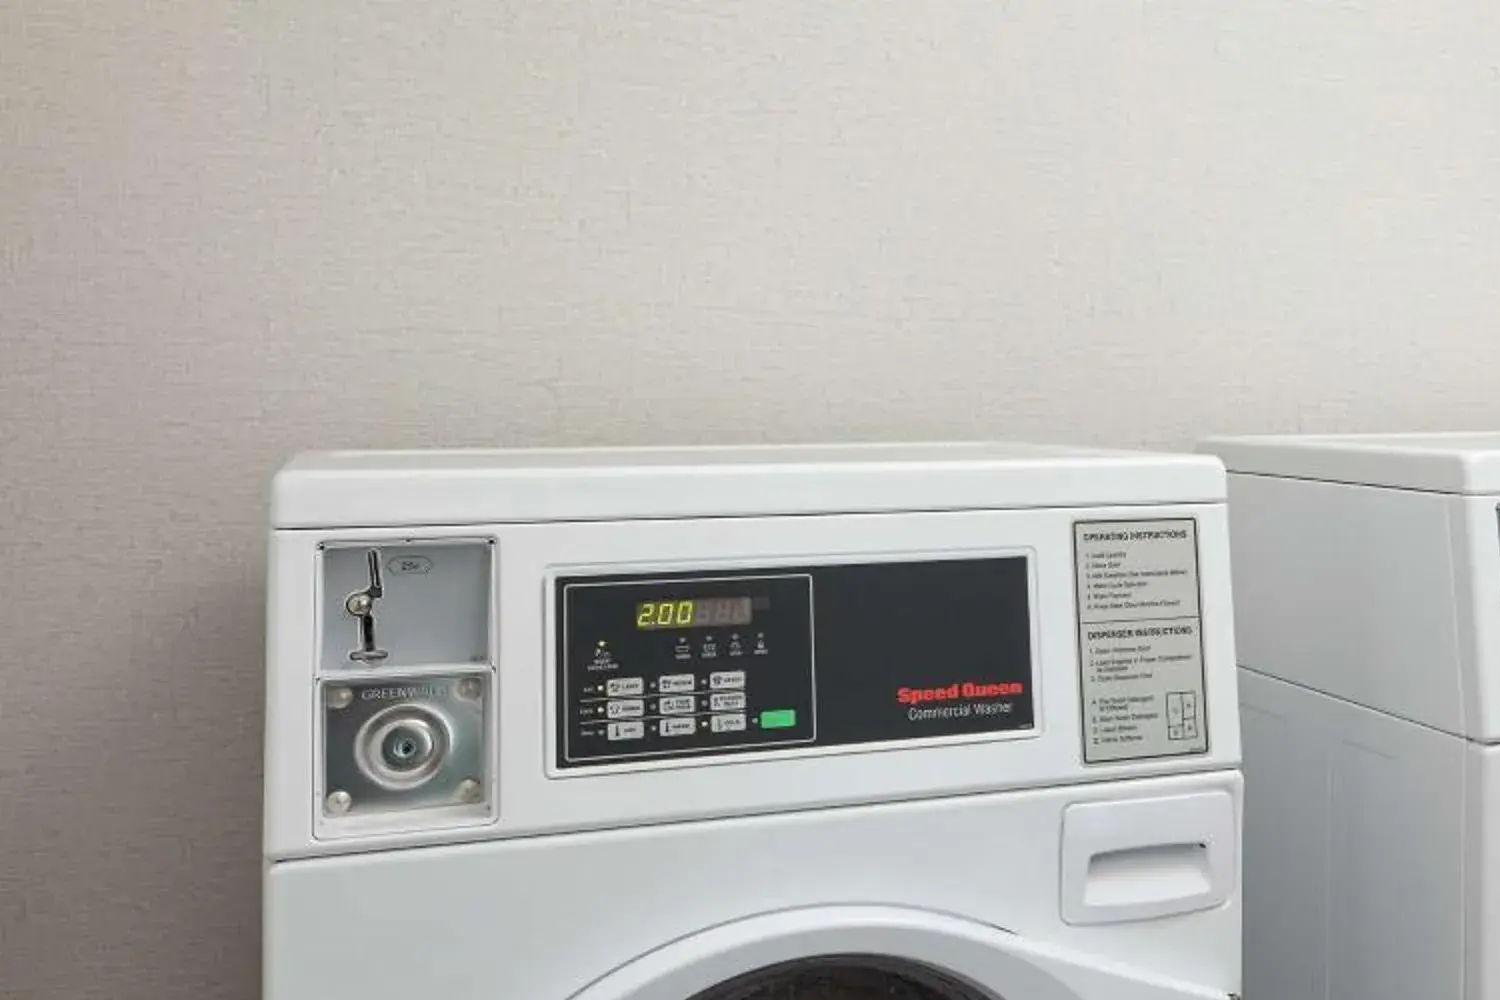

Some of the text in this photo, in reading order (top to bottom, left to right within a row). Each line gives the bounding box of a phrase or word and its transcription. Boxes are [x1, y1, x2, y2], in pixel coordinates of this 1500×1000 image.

[637, 601, 693, 627] 2.00
[897, 682, 1023, 704] Speed Queen
[908, 702, 1012, 721] Commercial Washer
